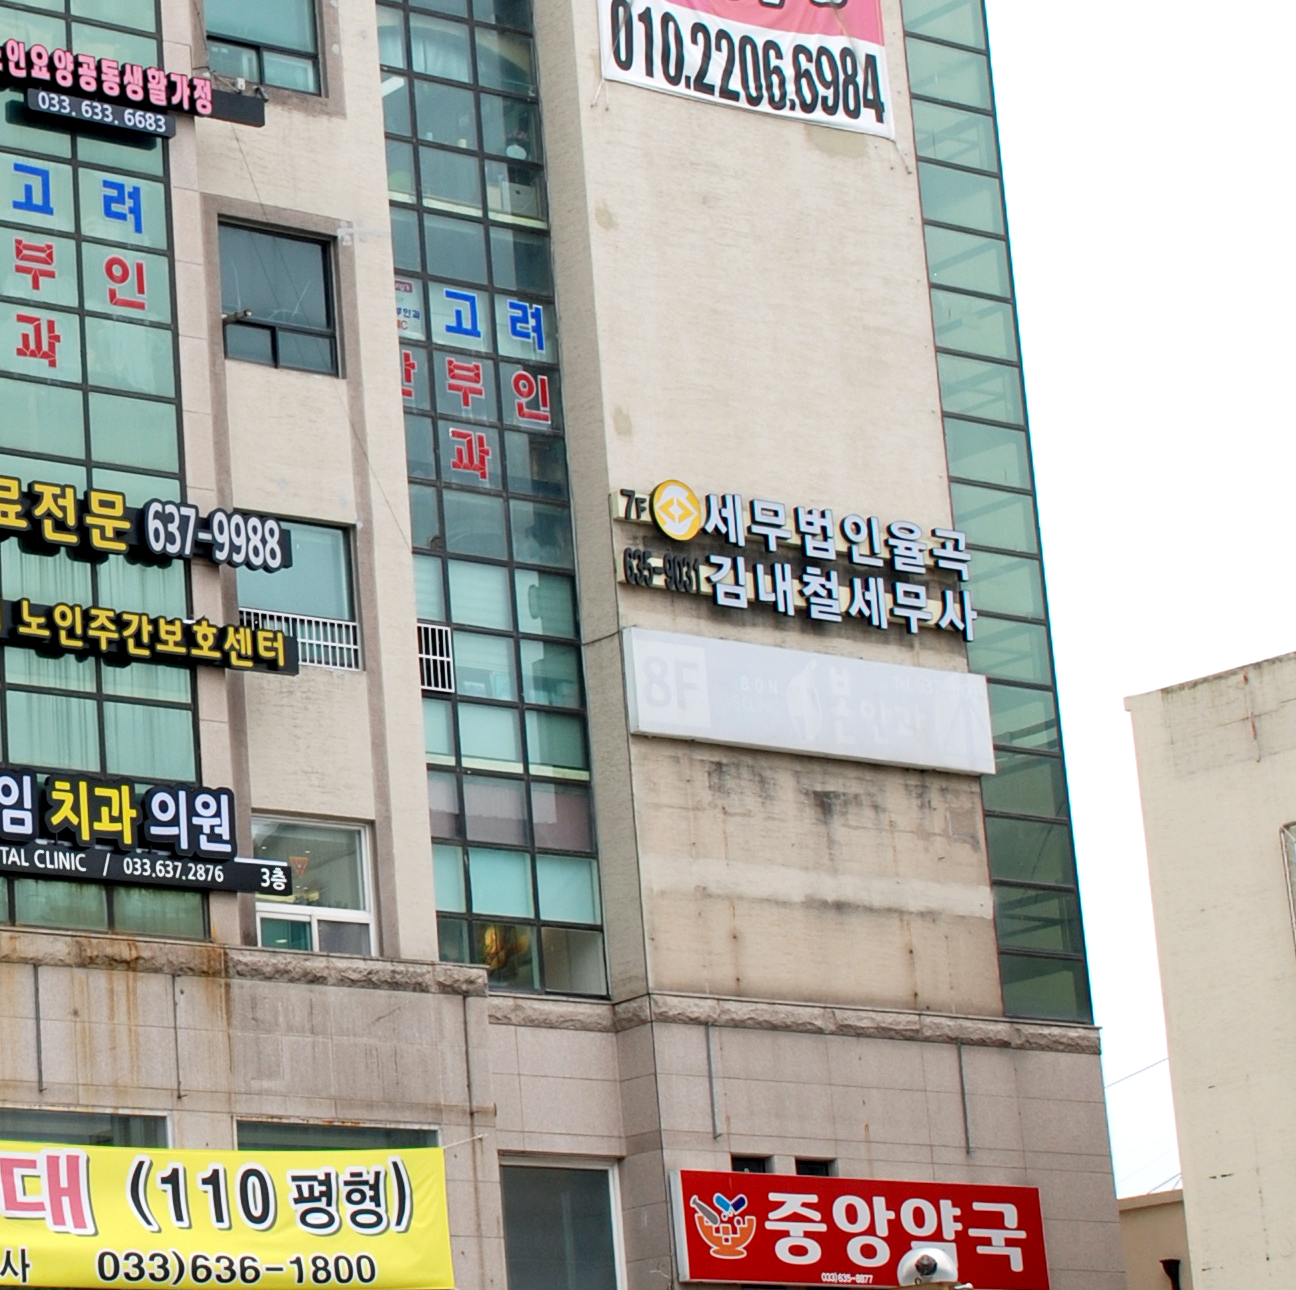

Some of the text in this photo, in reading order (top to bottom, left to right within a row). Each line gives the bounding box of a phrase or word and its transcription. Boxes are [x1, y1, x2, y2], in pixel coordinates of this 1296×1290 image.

[12, 162, 144, 235] 고려
[443, 287, 546, 353] 고려
[146, 500, 283, 570] 637-9988
[620, 488, 972, 581] 7F 세무법인율곡
[624, 547, 978, 642] 635-9031 김내철세무사
[18, 598, 286, 669] 노인주간보호센터
[50, 779, 138, 845] 치과
[149, 789, 234, 852] 의원
[34, 849, 87, 873] CLINIC
[122, 857, 225, 882] 033.637.2876
[260, 866, 288, 892] 3층
[128, 1155, 276, 1231] (110
[96, 1249, 377, 1286] 033)636-1800
[765, 1191, 1027, 1273] 중앙약국
